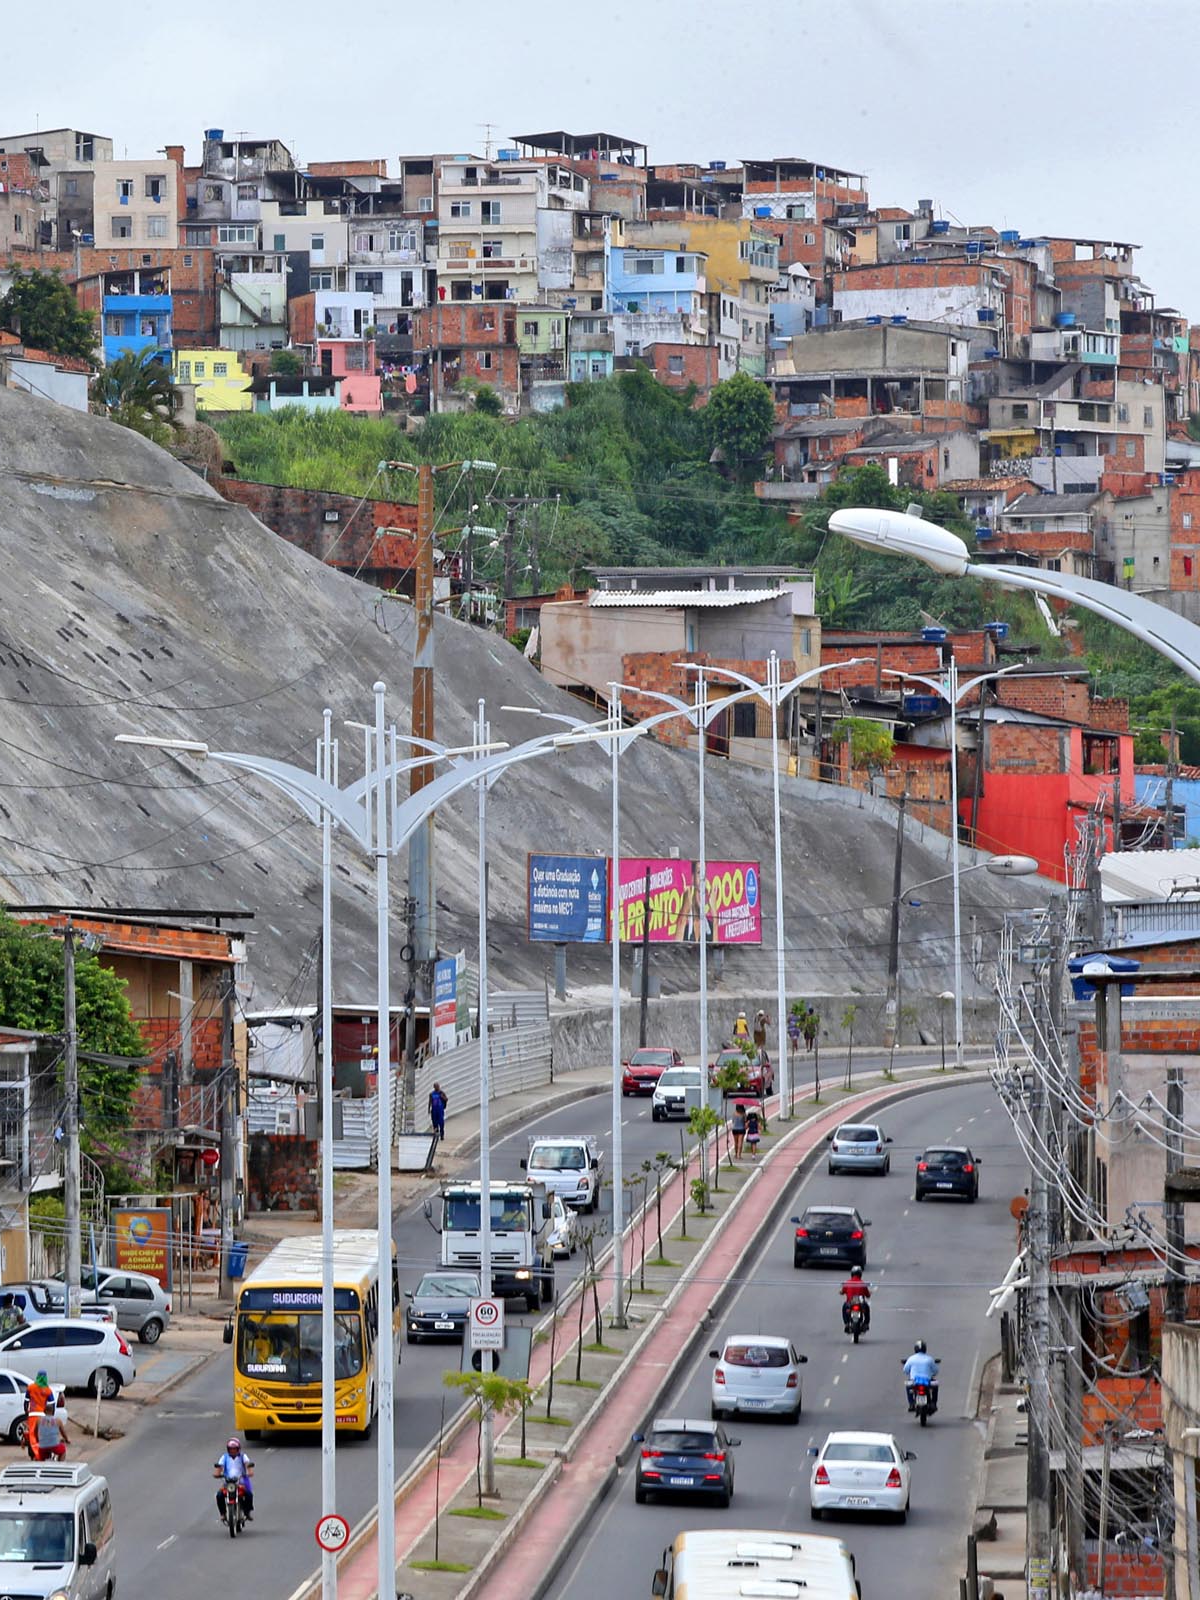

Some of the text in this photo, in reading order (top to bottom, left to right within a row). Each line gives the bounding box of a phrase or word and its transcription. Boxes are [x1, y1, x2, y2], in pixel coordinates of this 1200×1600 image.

[533, 867, 581, 885] Quer uma Graduação
[538, 884, 557, 898] distância
[558, 888, 567, 898] com
[568, 887, 580, 899] nota
[534, 900, 551, 914] máxima
[272, 1293, 323, 1304] SUBURBAN
[480, 1307, 493, 1315] 60
